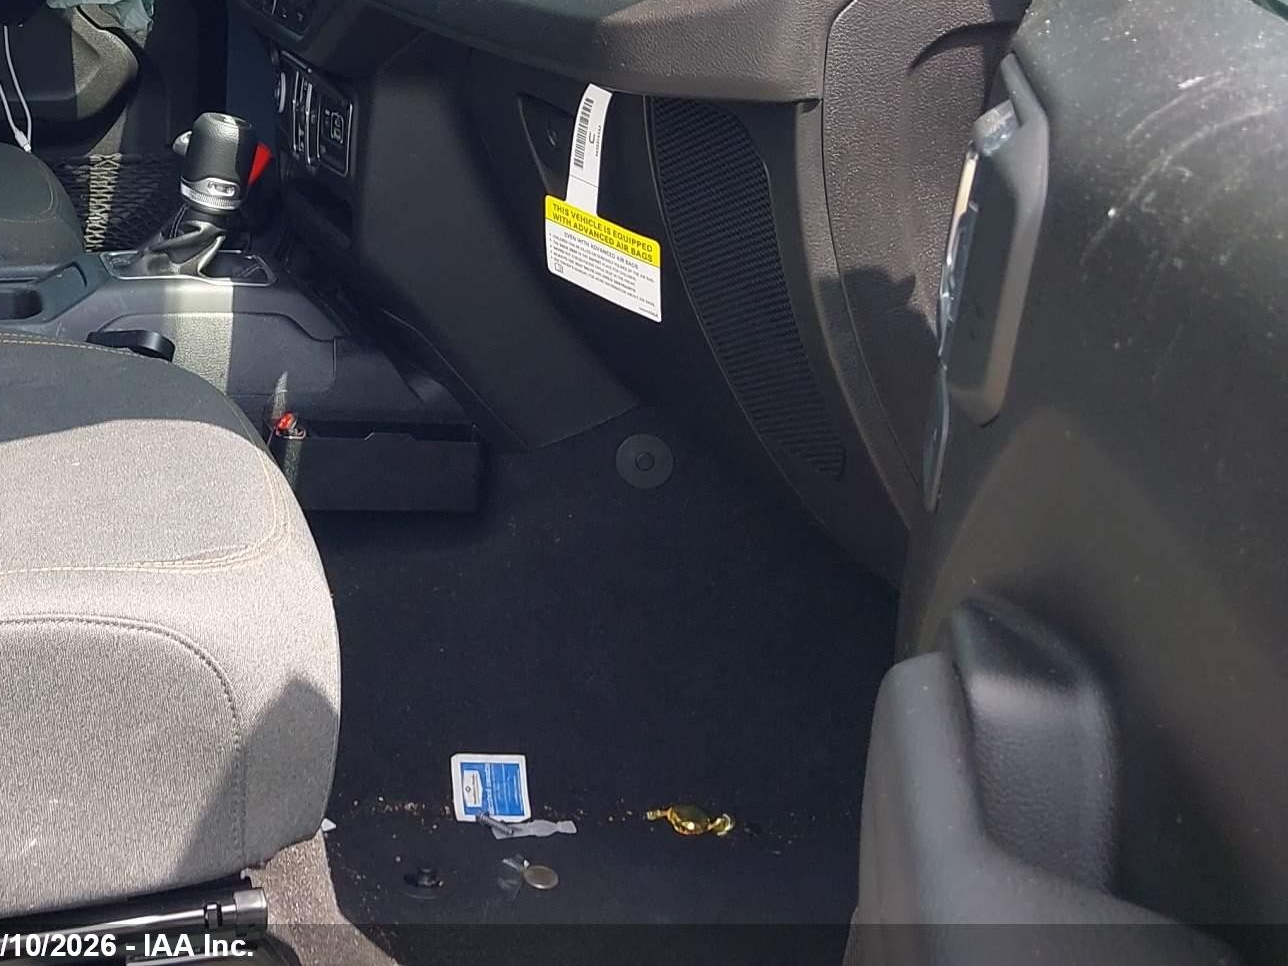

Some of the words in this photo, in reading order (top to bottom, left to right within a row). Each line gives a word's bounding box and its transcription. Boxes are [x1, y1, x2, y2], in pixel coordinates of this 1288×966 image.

[553, 203, 569, 216] THIS
[571, 211, 603, 229] VEHICLE
[603, 224, 611, 235] IS
[612, 228, 653, 253] EQUIPPED
[553, 212, 572, 227] WITH
[573, 221, 614, 245] ADVANCED
[616, 239, 629, 252] AIR
[630, 245, 653, 263] BAGS
[590, 243, 616, 259] ADVANCED
[616, 254, 625, 263] AIR
